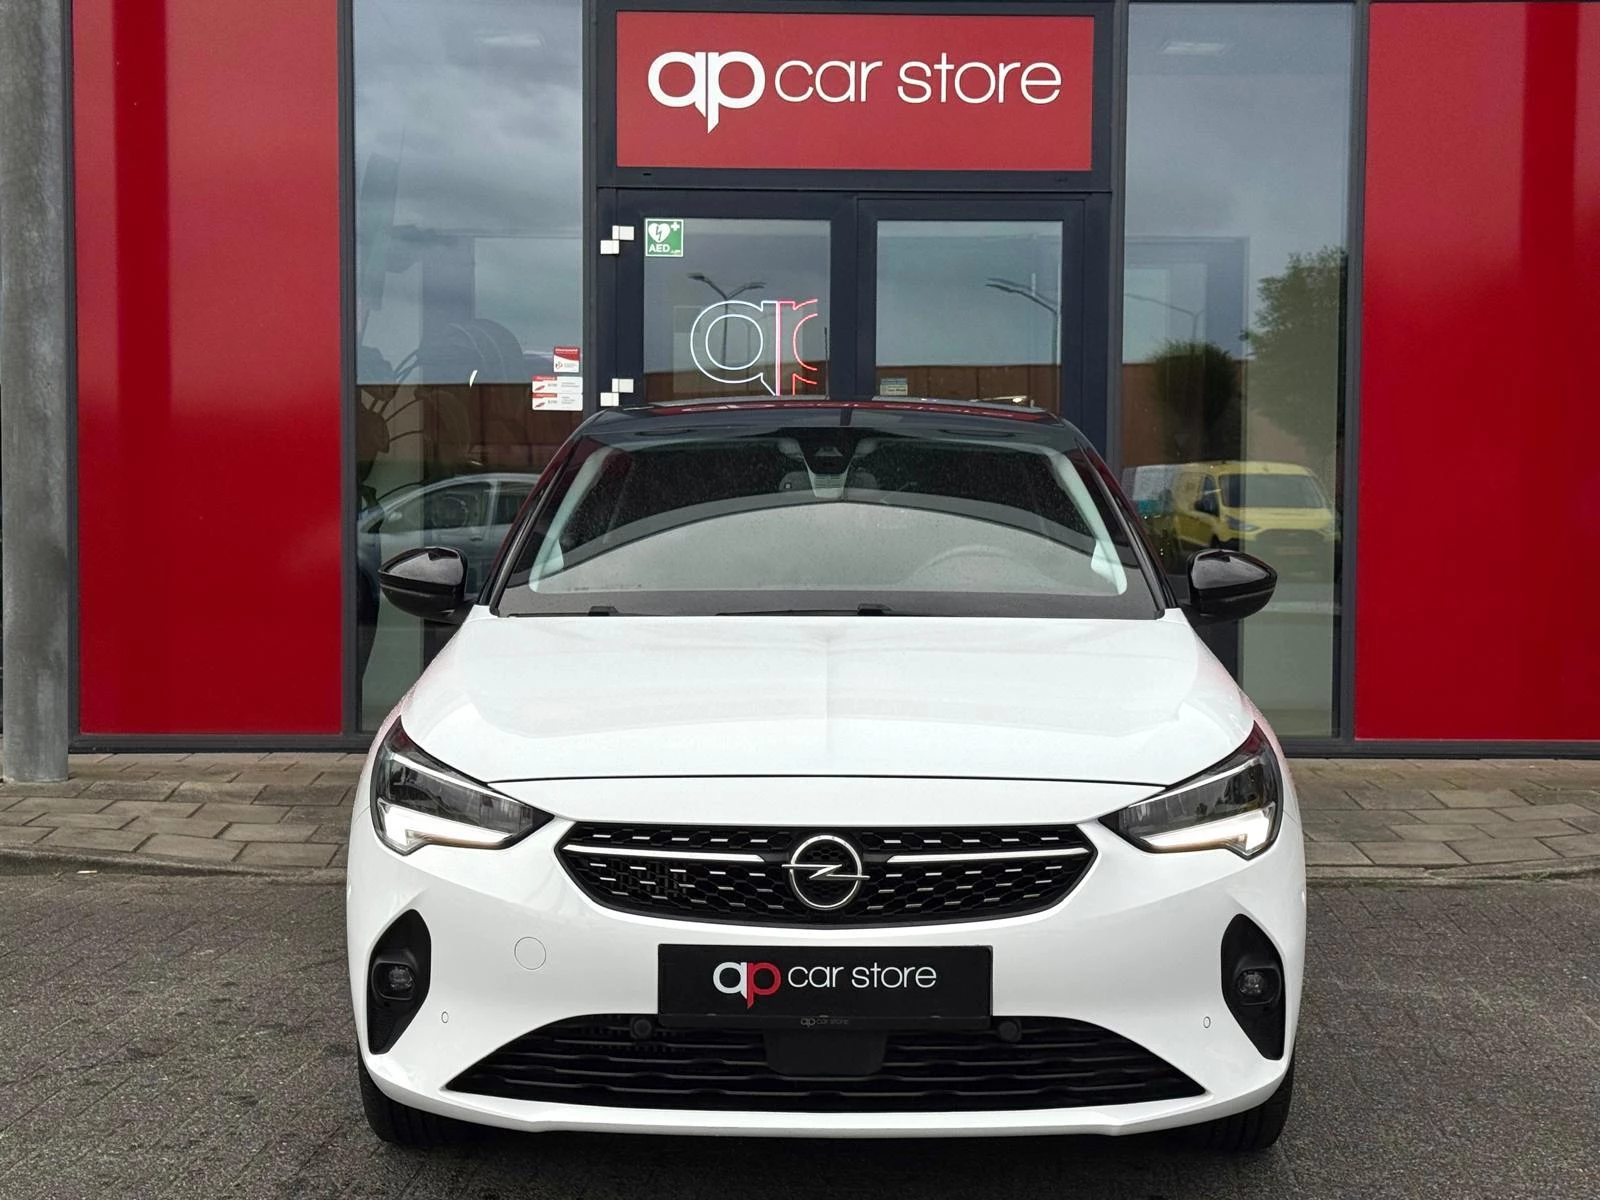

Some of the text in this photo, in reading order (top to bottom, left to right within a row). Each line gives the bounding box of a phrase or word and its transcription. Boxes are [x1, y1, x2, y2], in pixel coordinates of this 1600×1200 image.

[648, 51, 1062, 134] ap car store
[649, 243, 670, 253] AED
[713, 961, 937, 1009] ap car store
